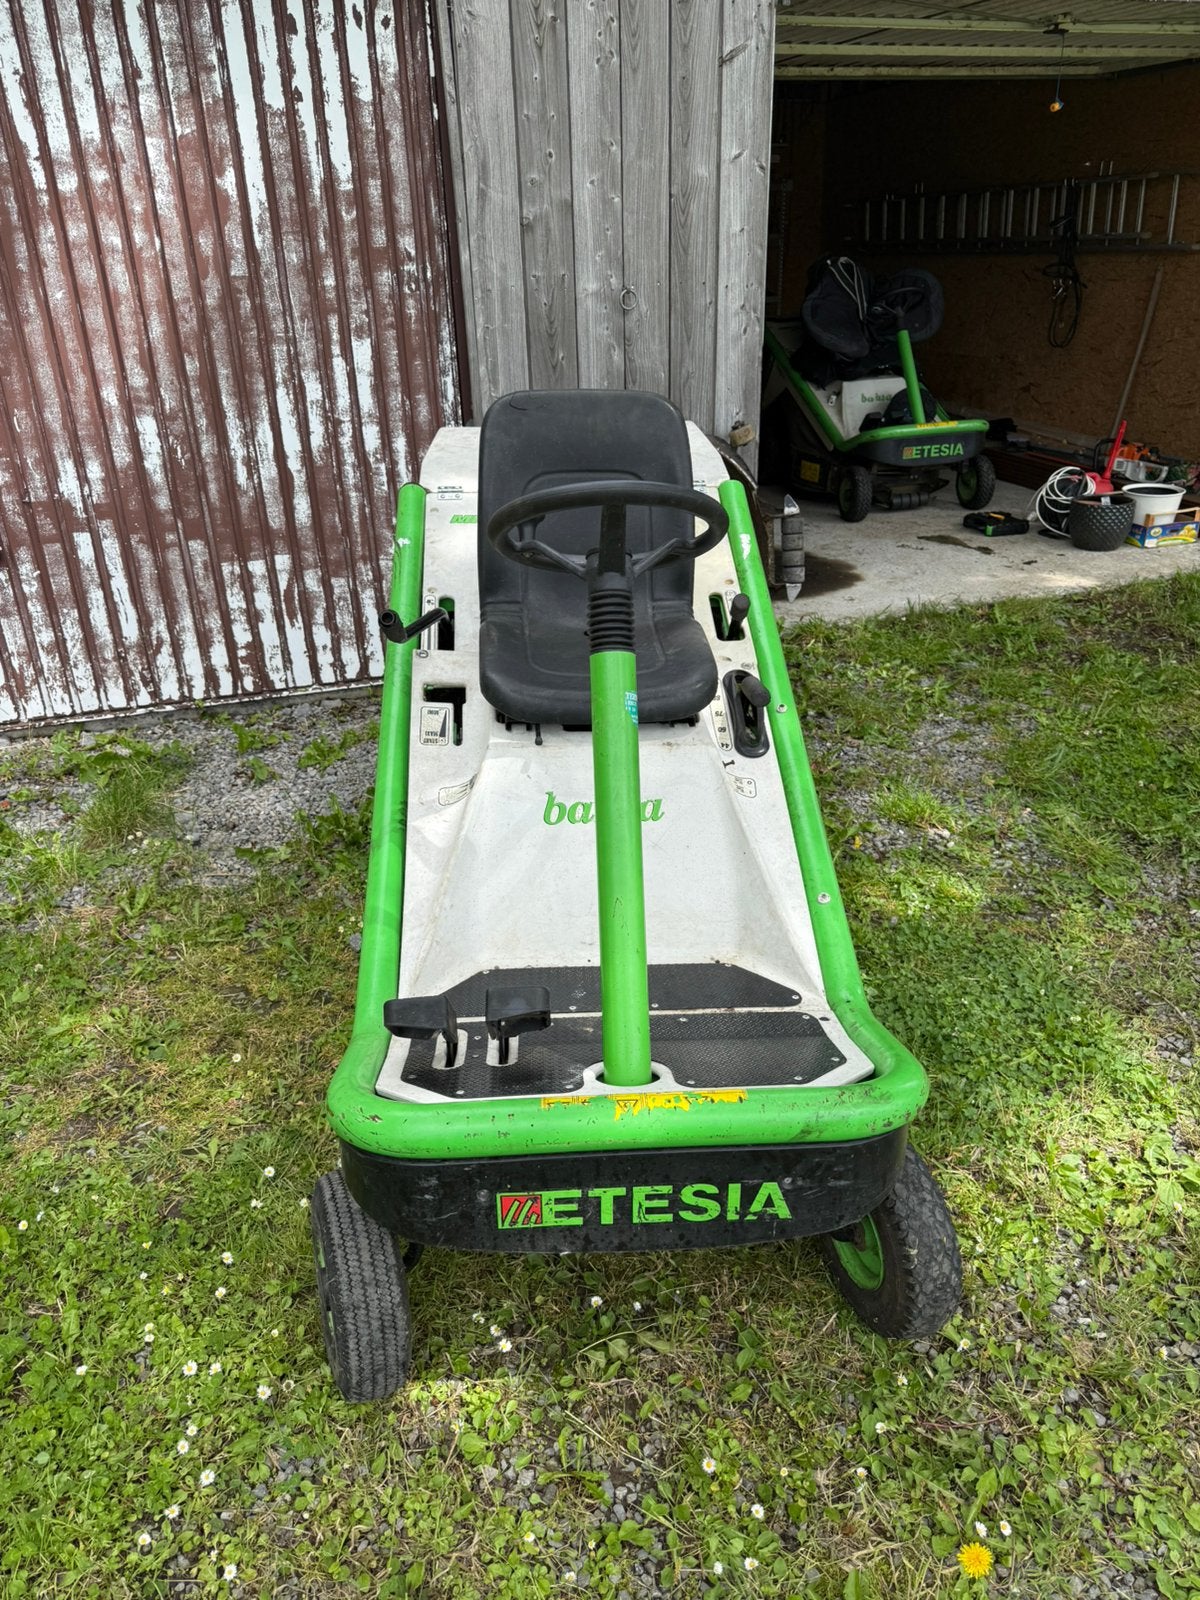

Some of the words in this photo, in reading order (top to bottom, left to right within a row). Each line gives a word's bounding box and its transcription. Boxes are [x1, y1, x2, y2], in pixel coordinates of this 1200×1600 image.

[912, 443, 964, 458] ETESIA
[543, 791, 664, 825] baa
[542, 1182, 793, 1226] ETESIA
